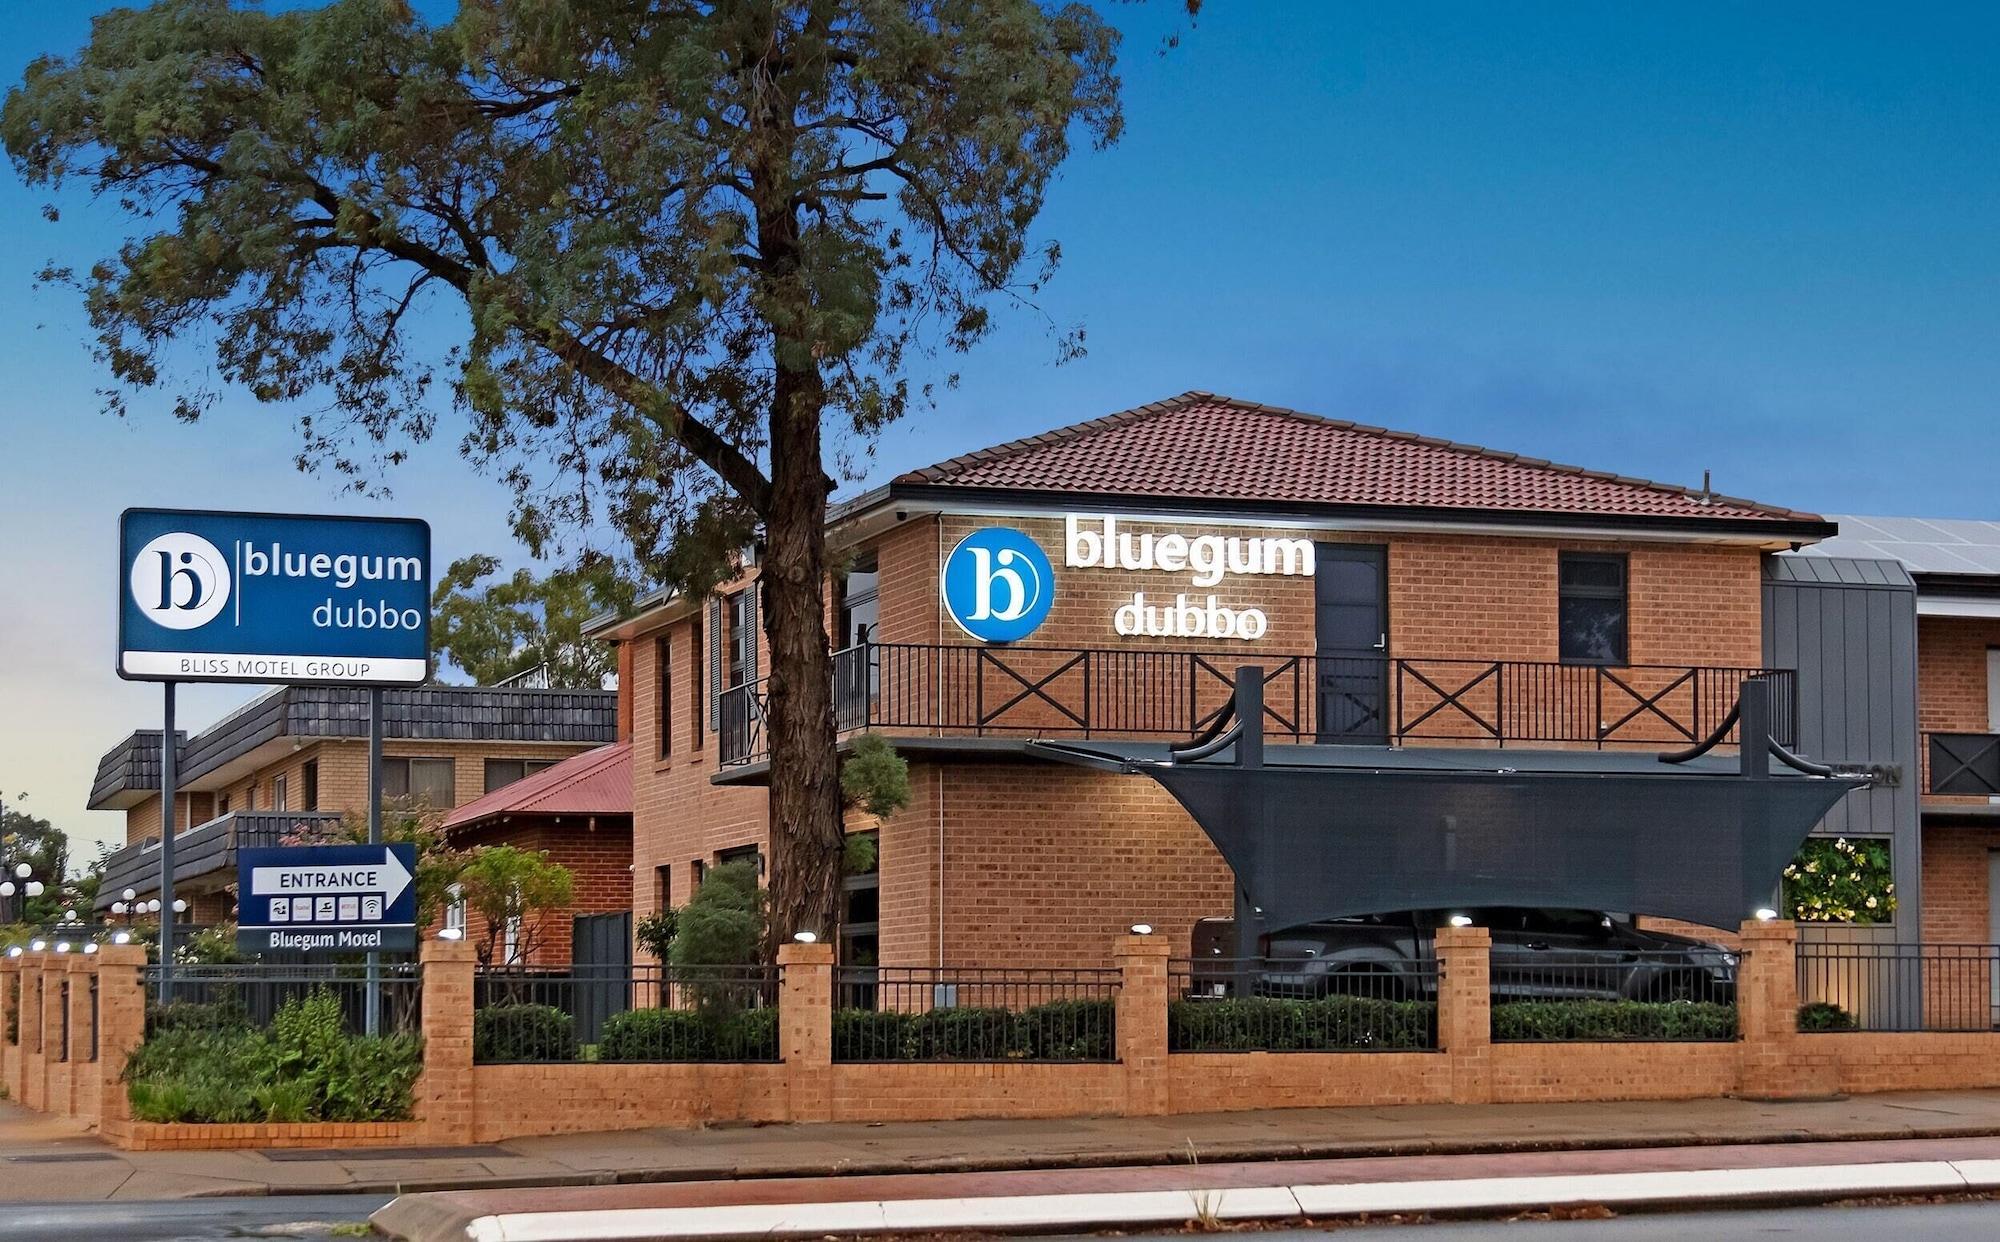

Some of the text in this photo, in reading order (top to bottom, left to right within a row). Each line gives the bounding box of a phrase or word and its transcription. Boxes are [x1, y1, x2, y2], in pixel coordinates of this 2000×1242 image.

[244, 541, 423, 589] bluegum
[1065, 515, 1316, 588] bluegum
[311, 598, 422, 631] dubbo
[1113, 592, 1268, 641] dubbo
[180, 658, 371, 678] BLISS MOTEL GROUP
[280, 871, 377, 888] ENTRANCE
[269, 929, 382, 951] Bluegum Motel
